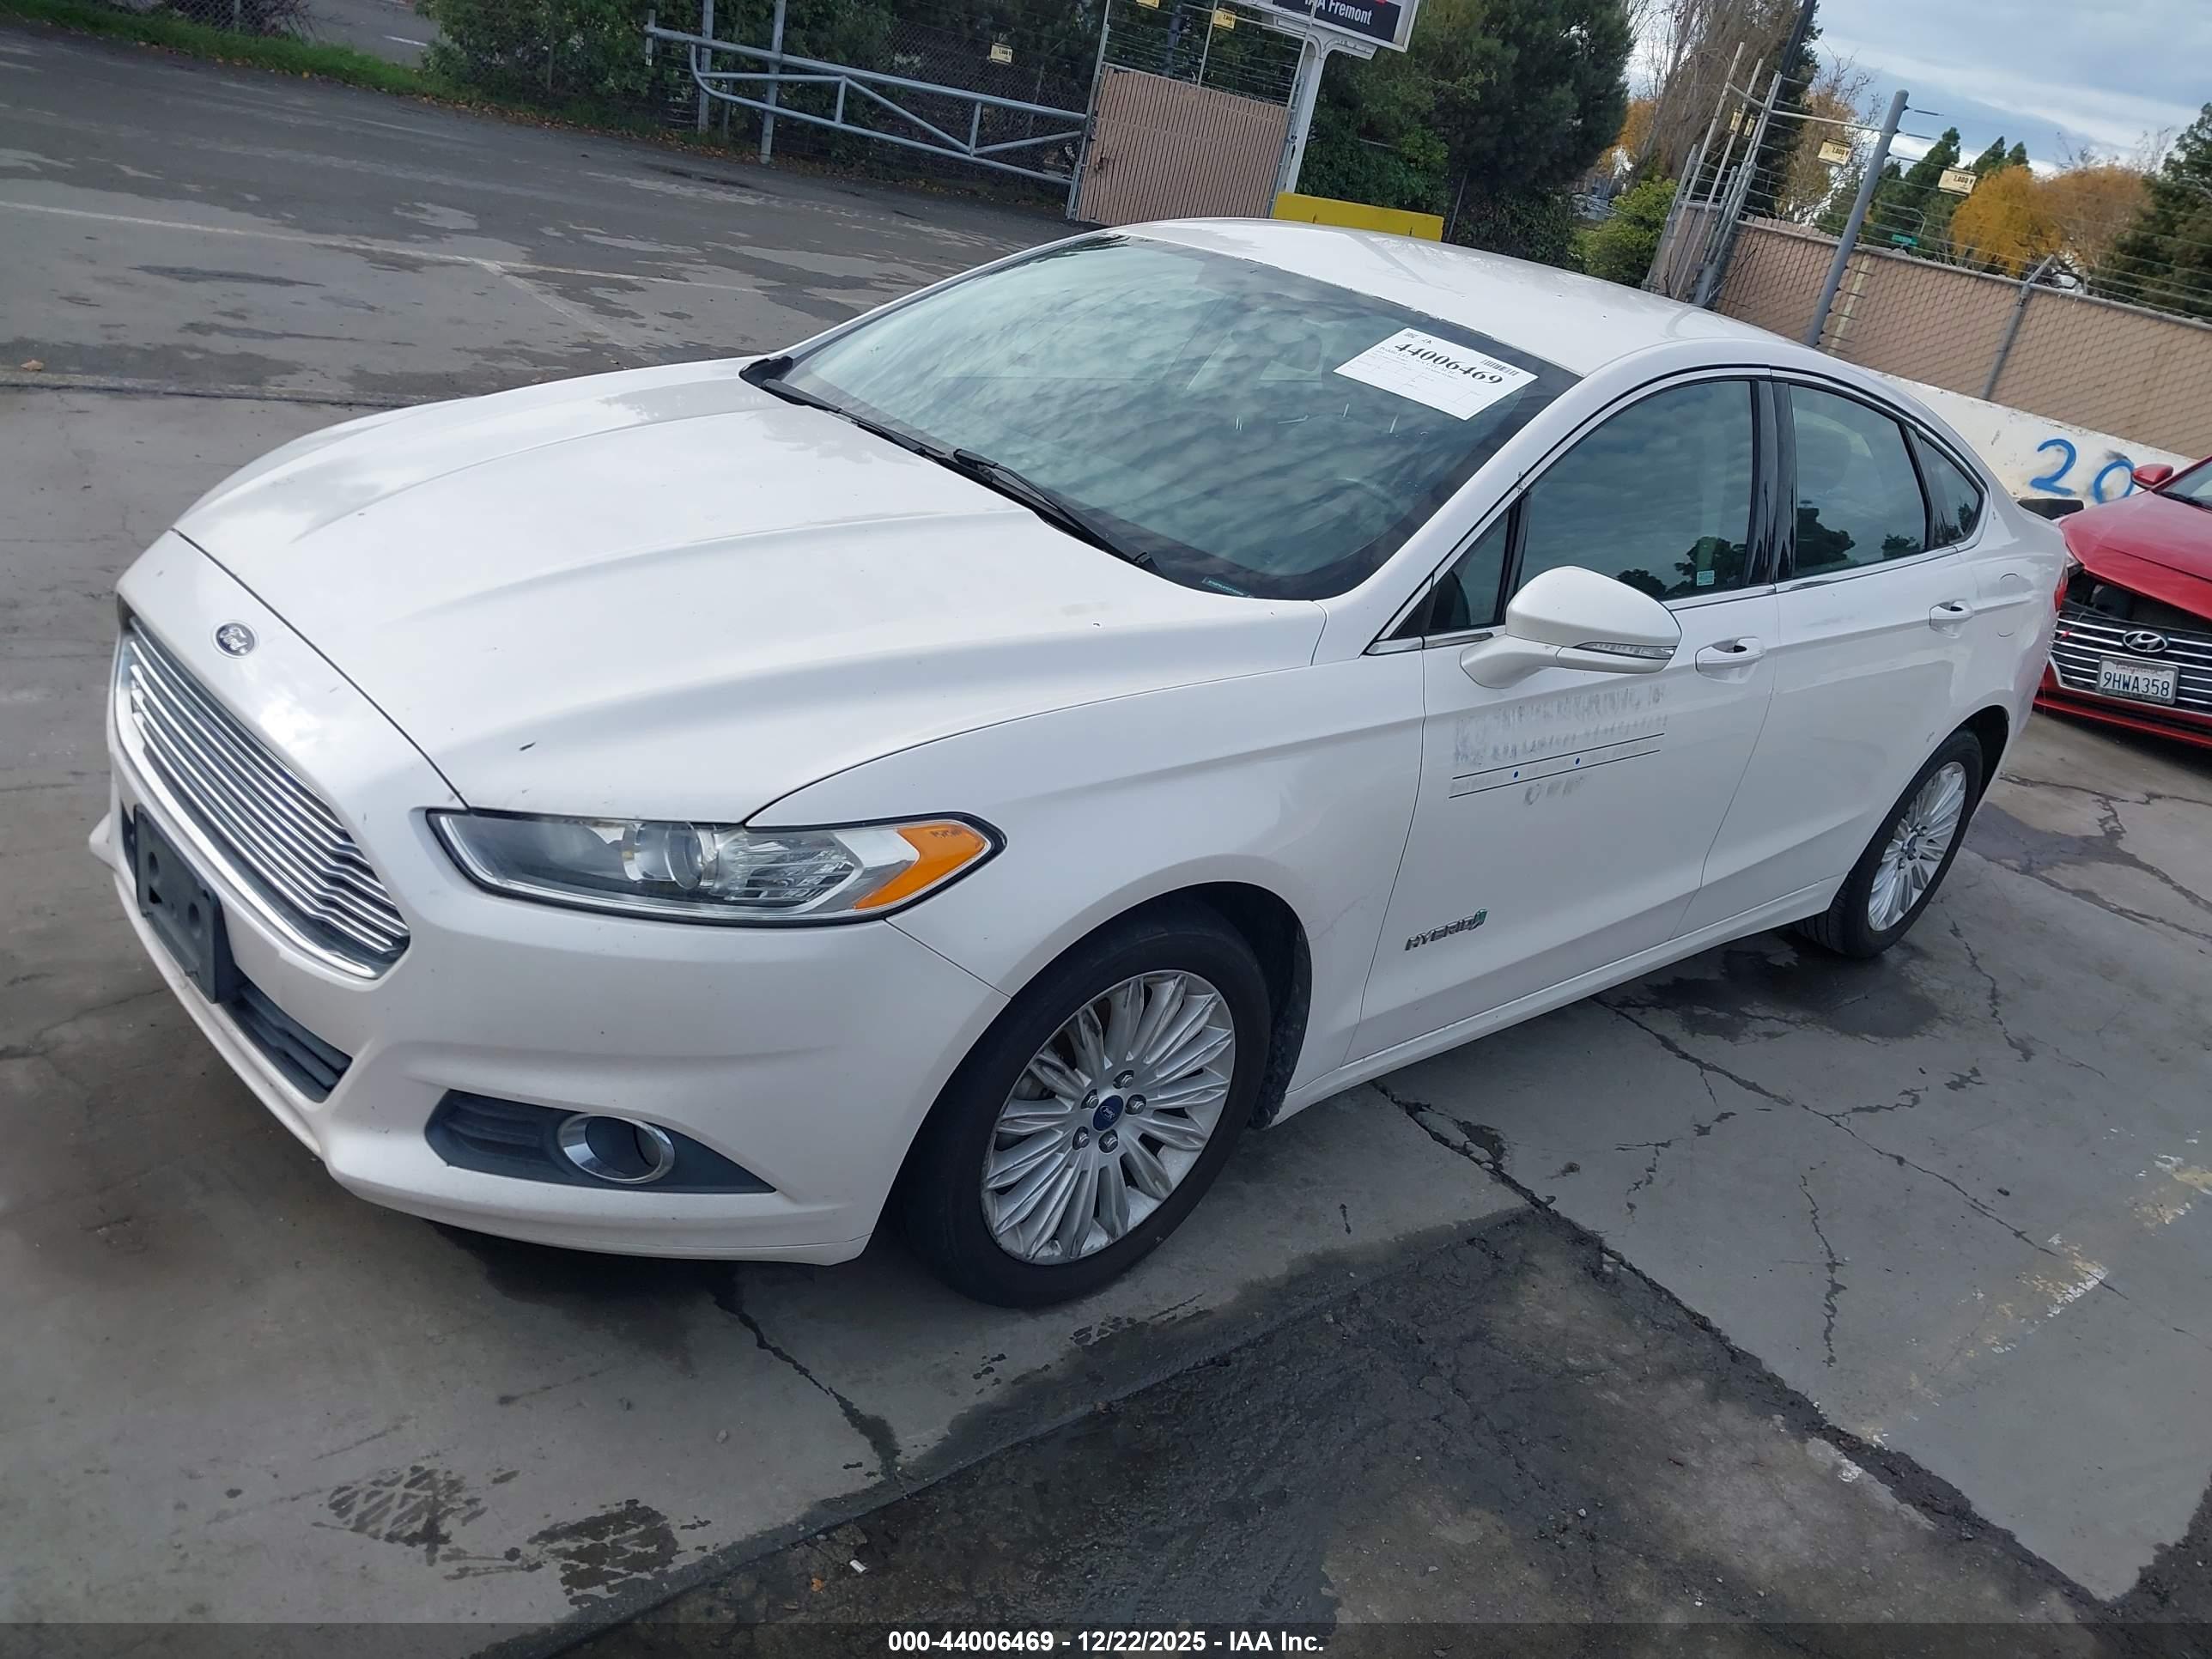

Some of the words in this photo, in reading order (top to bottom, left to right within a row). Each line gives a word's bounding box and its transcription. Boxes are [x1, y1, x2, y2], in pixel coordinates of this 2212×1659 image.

[1328, 0, 1372, 25] Fremont
[1395, 343, 1503, 384] 44006469
[2103, 672, 2171, 697] 9HWA358
